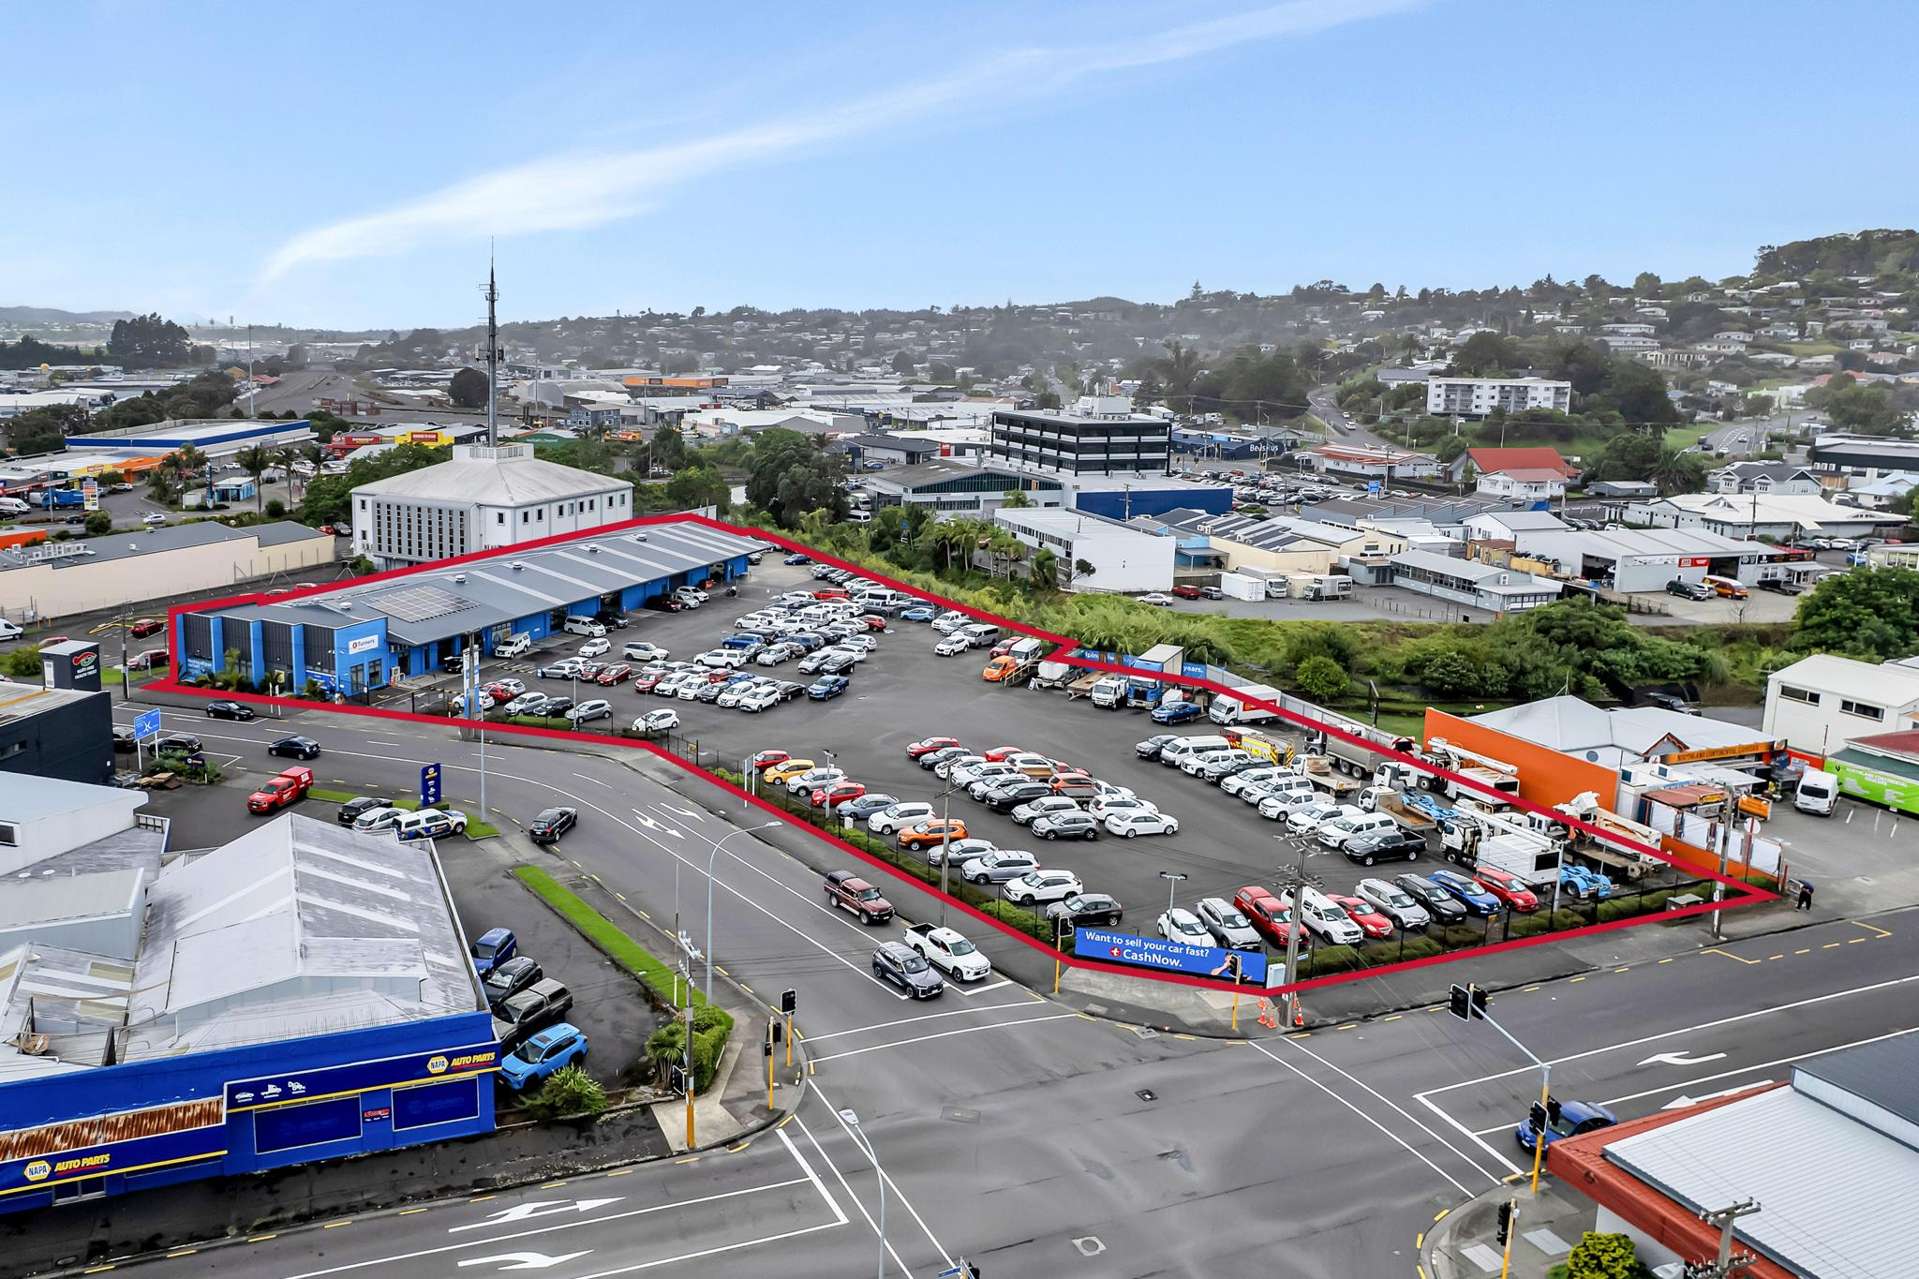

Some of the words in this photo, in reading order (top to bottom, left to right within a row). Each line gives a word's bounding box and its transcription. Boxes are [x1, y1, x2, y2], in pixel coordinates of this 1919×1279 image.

[1250, 443, 1278, 452] Bedsus
[1086, 931, 1110, 943] Want
[1112, 936, 1124, 945] to
[1125, 937, 1142, 948] sell
[1143, 942, 1166, 955] your
[1168, 945, 1184, 954] car
[1185, 947, 1209, 958] fast?
[1123, 949, 1182, 968] CashNow.
[451, 1056, 472, 1067] AUTO
[472, 1052, 496, 1064] PARTS
[29, 1165, 48, 1176] NAPA
[54, 1159, 80, 1172] AUTO
[81, 1153, 110, 1167] PARTS
